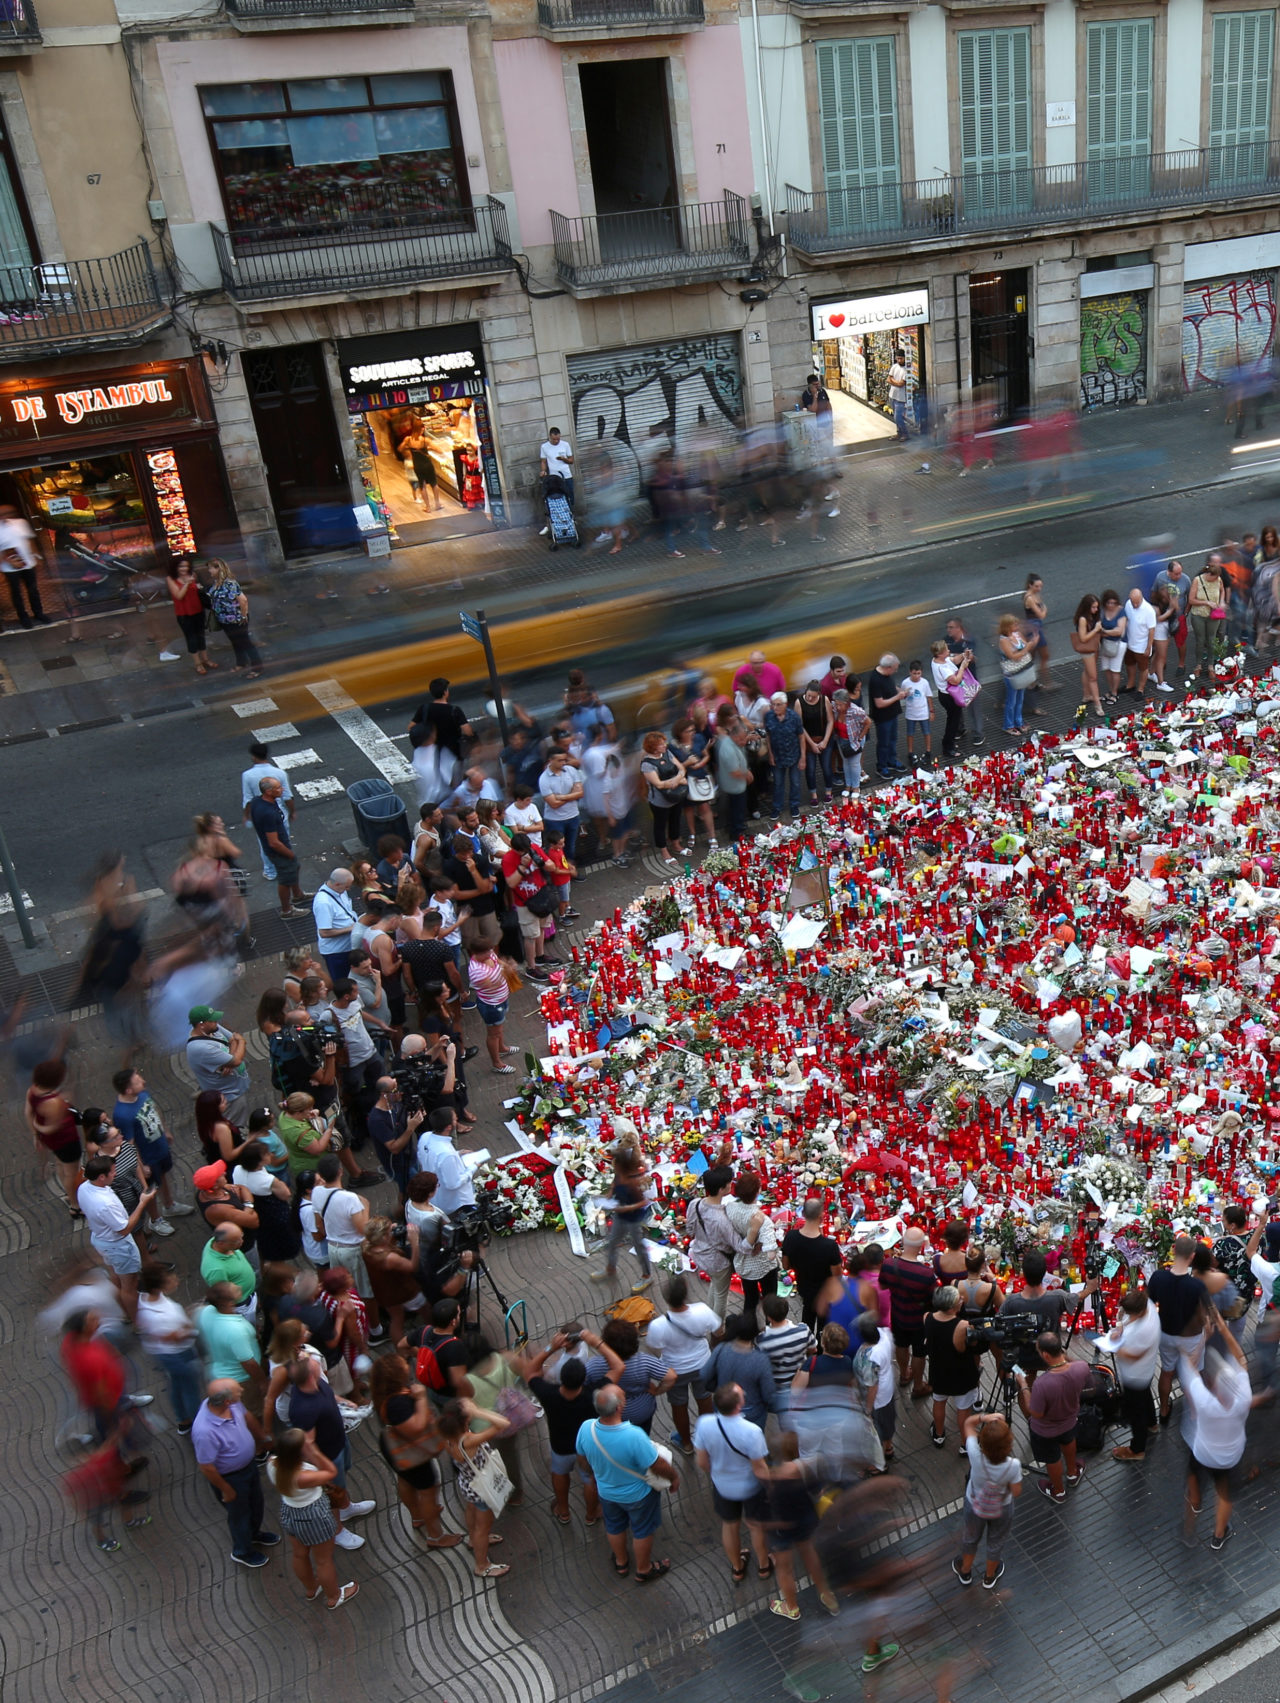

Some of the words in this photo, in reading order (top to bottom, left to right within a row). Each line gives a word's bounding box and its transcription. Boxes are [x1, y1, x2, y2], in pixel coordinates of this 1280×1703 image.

[716, 143, 726, 154] 71
[87, 173, 101, 185] 67
[992, 250, 1003, 261] 73
[818, 315, 826, 331] I
[848, 303, 924, 327] Barcelona
[349, 358, 424, 383] SOUVENIRS
[423, 350, 475, 373] SPORTS
[381, 377, 421, 388] ARTICLES
[421, 373, 449, 382] REGAL
[433, 388, 441, 399] 9
[450, 383, 459, 397] 7
[11, 396, 47, 422] DE
[55, 379, 172, 424] ISTAMBUL
[393, 391, 406, 404] 10
